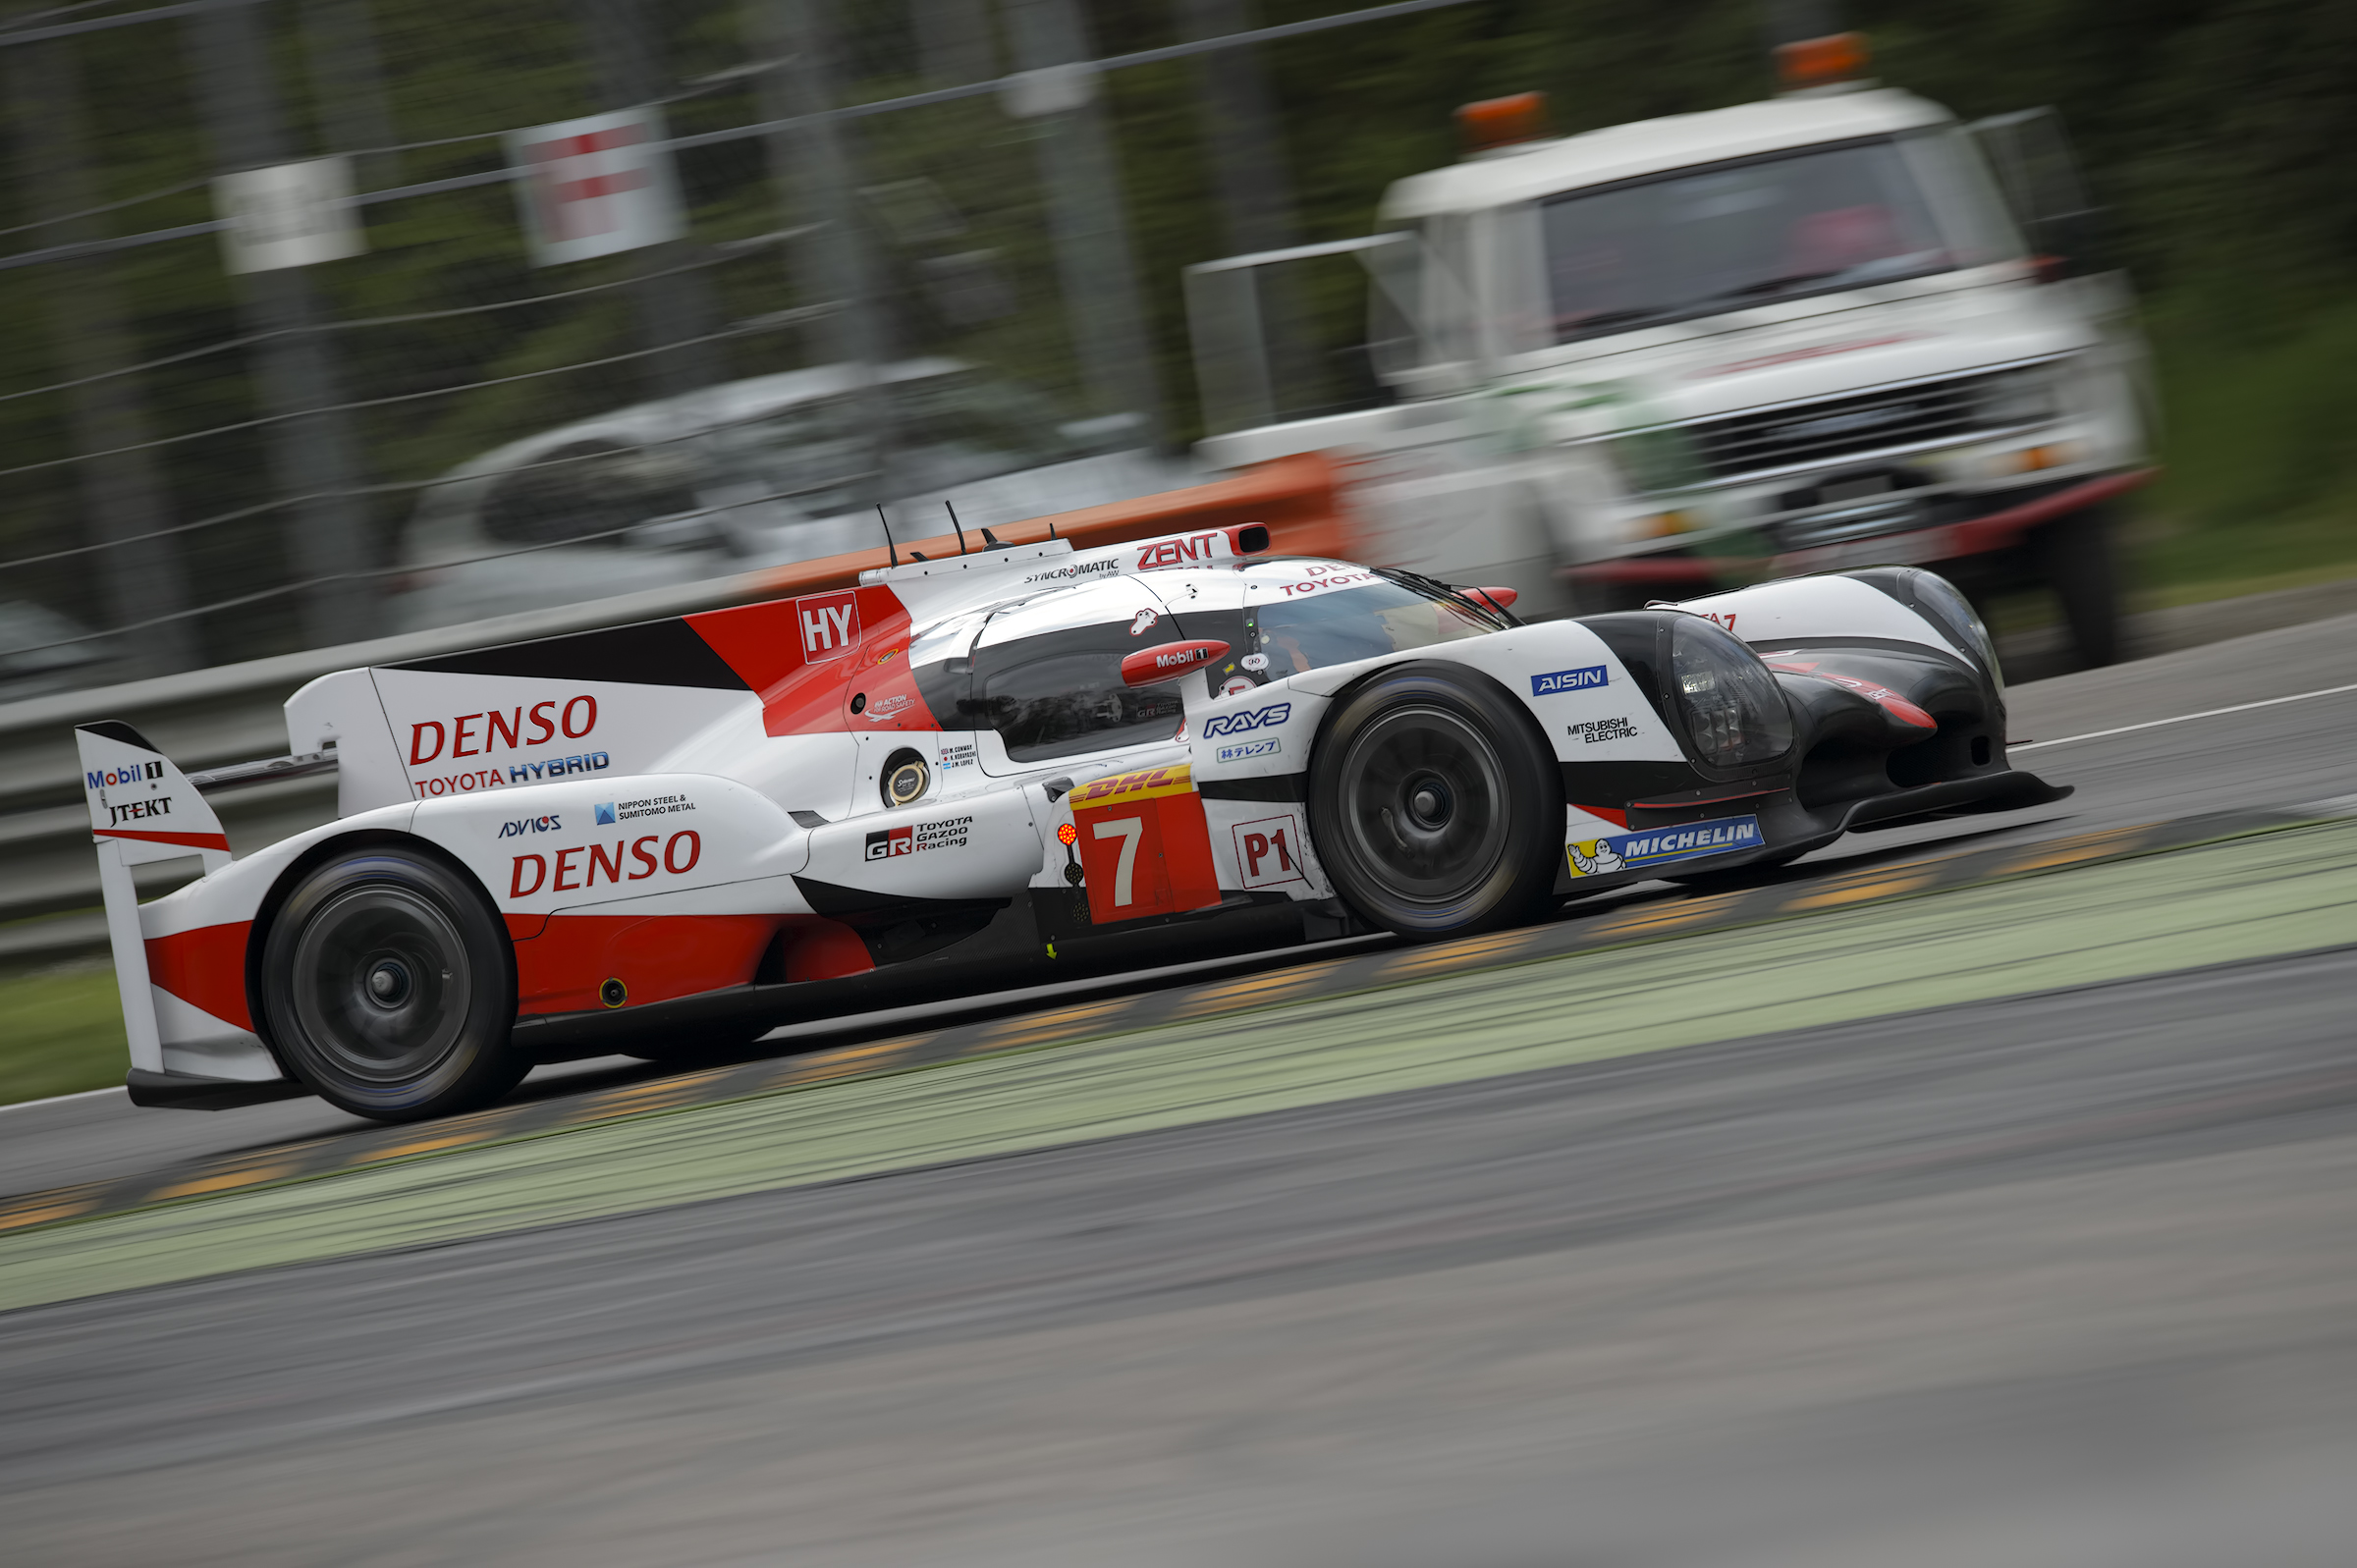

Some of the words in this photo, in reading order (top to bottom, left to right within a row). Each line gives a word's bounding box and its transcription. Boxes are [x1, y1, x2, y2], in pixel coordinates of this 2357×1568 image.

[1137, 532, 1218, 570] ZENT
[1280, 573, 1376, 597] TOYOTA
[801, 603, 852, 653] HY
[1155, 649, 1194, 669] Mobil
[1194, 647, 1209, 661] 1
[1538, 669, 1602, 692] AISIN
[883, 693, 907, 706] ACTION
[409, 694, 598, 766] DENSO
[1203, 702, 1291, 739] RAYS
[1567, 717, 1628, 736] MITSUBISHI
[1584, 727, 1638, 744] ELECTRIC
[87, 763, 142, 789] Mobil
[145, 761, 163, 780] 1
[415, 769, 506, 798] TOYOTA
[509, 751, 610, 784] HYBRID
[1085, 769, 1174, 801] DHL
[109, 796, 173, 829] JTEKT
[618, 798, 651, 810] NIPPON
[653, 795, 679, 805] STEEL
[680, 793, 686, 802] &
[619, 806, 666, 821] SUMITOMO
[668, 803, 696, 813] METAL
[498, 815, 562, 838] ADVICS
[916, 815, 973, 833] TOYOTA
[916, 826, 968, 841] GAZOO
[866, 837, 912, 860] GR
[916, 837, 967, 851] Racing
[1624, 823, 1755, 857] MICHELIN
[509, 830, 701, 899] DENSO
[1093, 816, 1143, 907] 7
[1243, 828, 1292, 878] P1
